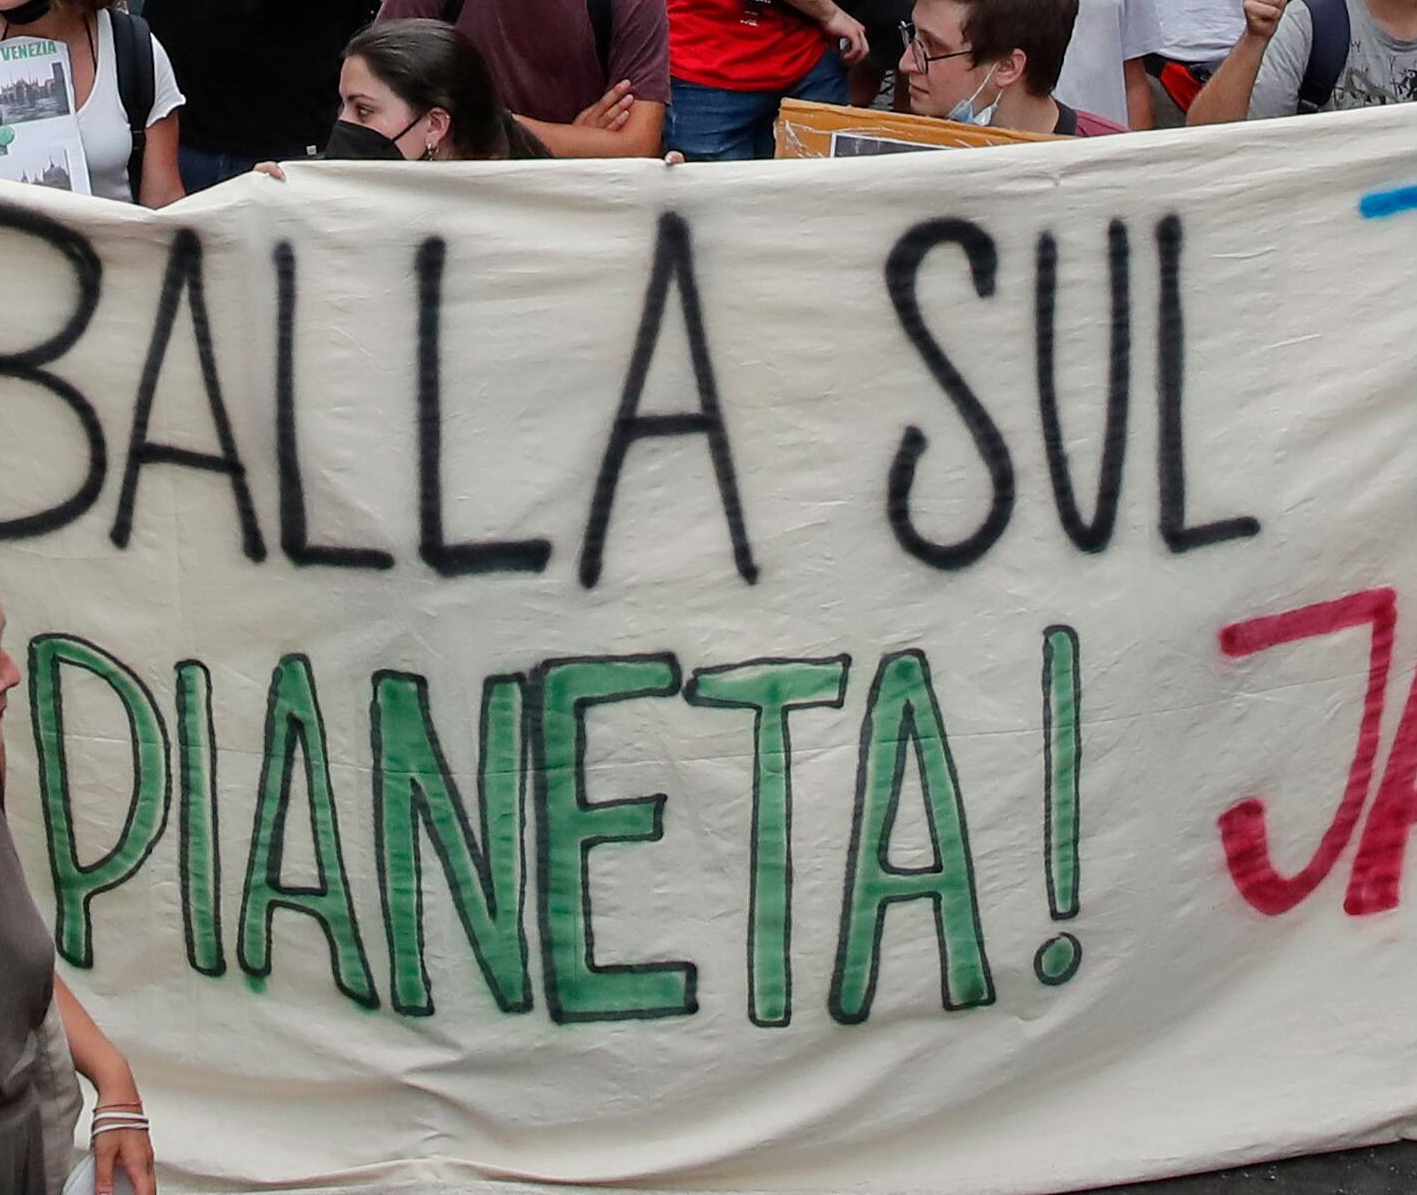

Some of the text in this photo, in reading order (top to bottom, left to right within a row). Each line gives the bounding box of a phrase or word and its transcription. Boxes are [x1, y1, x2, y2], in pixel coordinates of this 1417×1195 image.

[0, 40, 57, 62] VENEZIA
[884, 212, 1261, 570] SUL
[26, 626, 1084, 1026] PIANETA!
